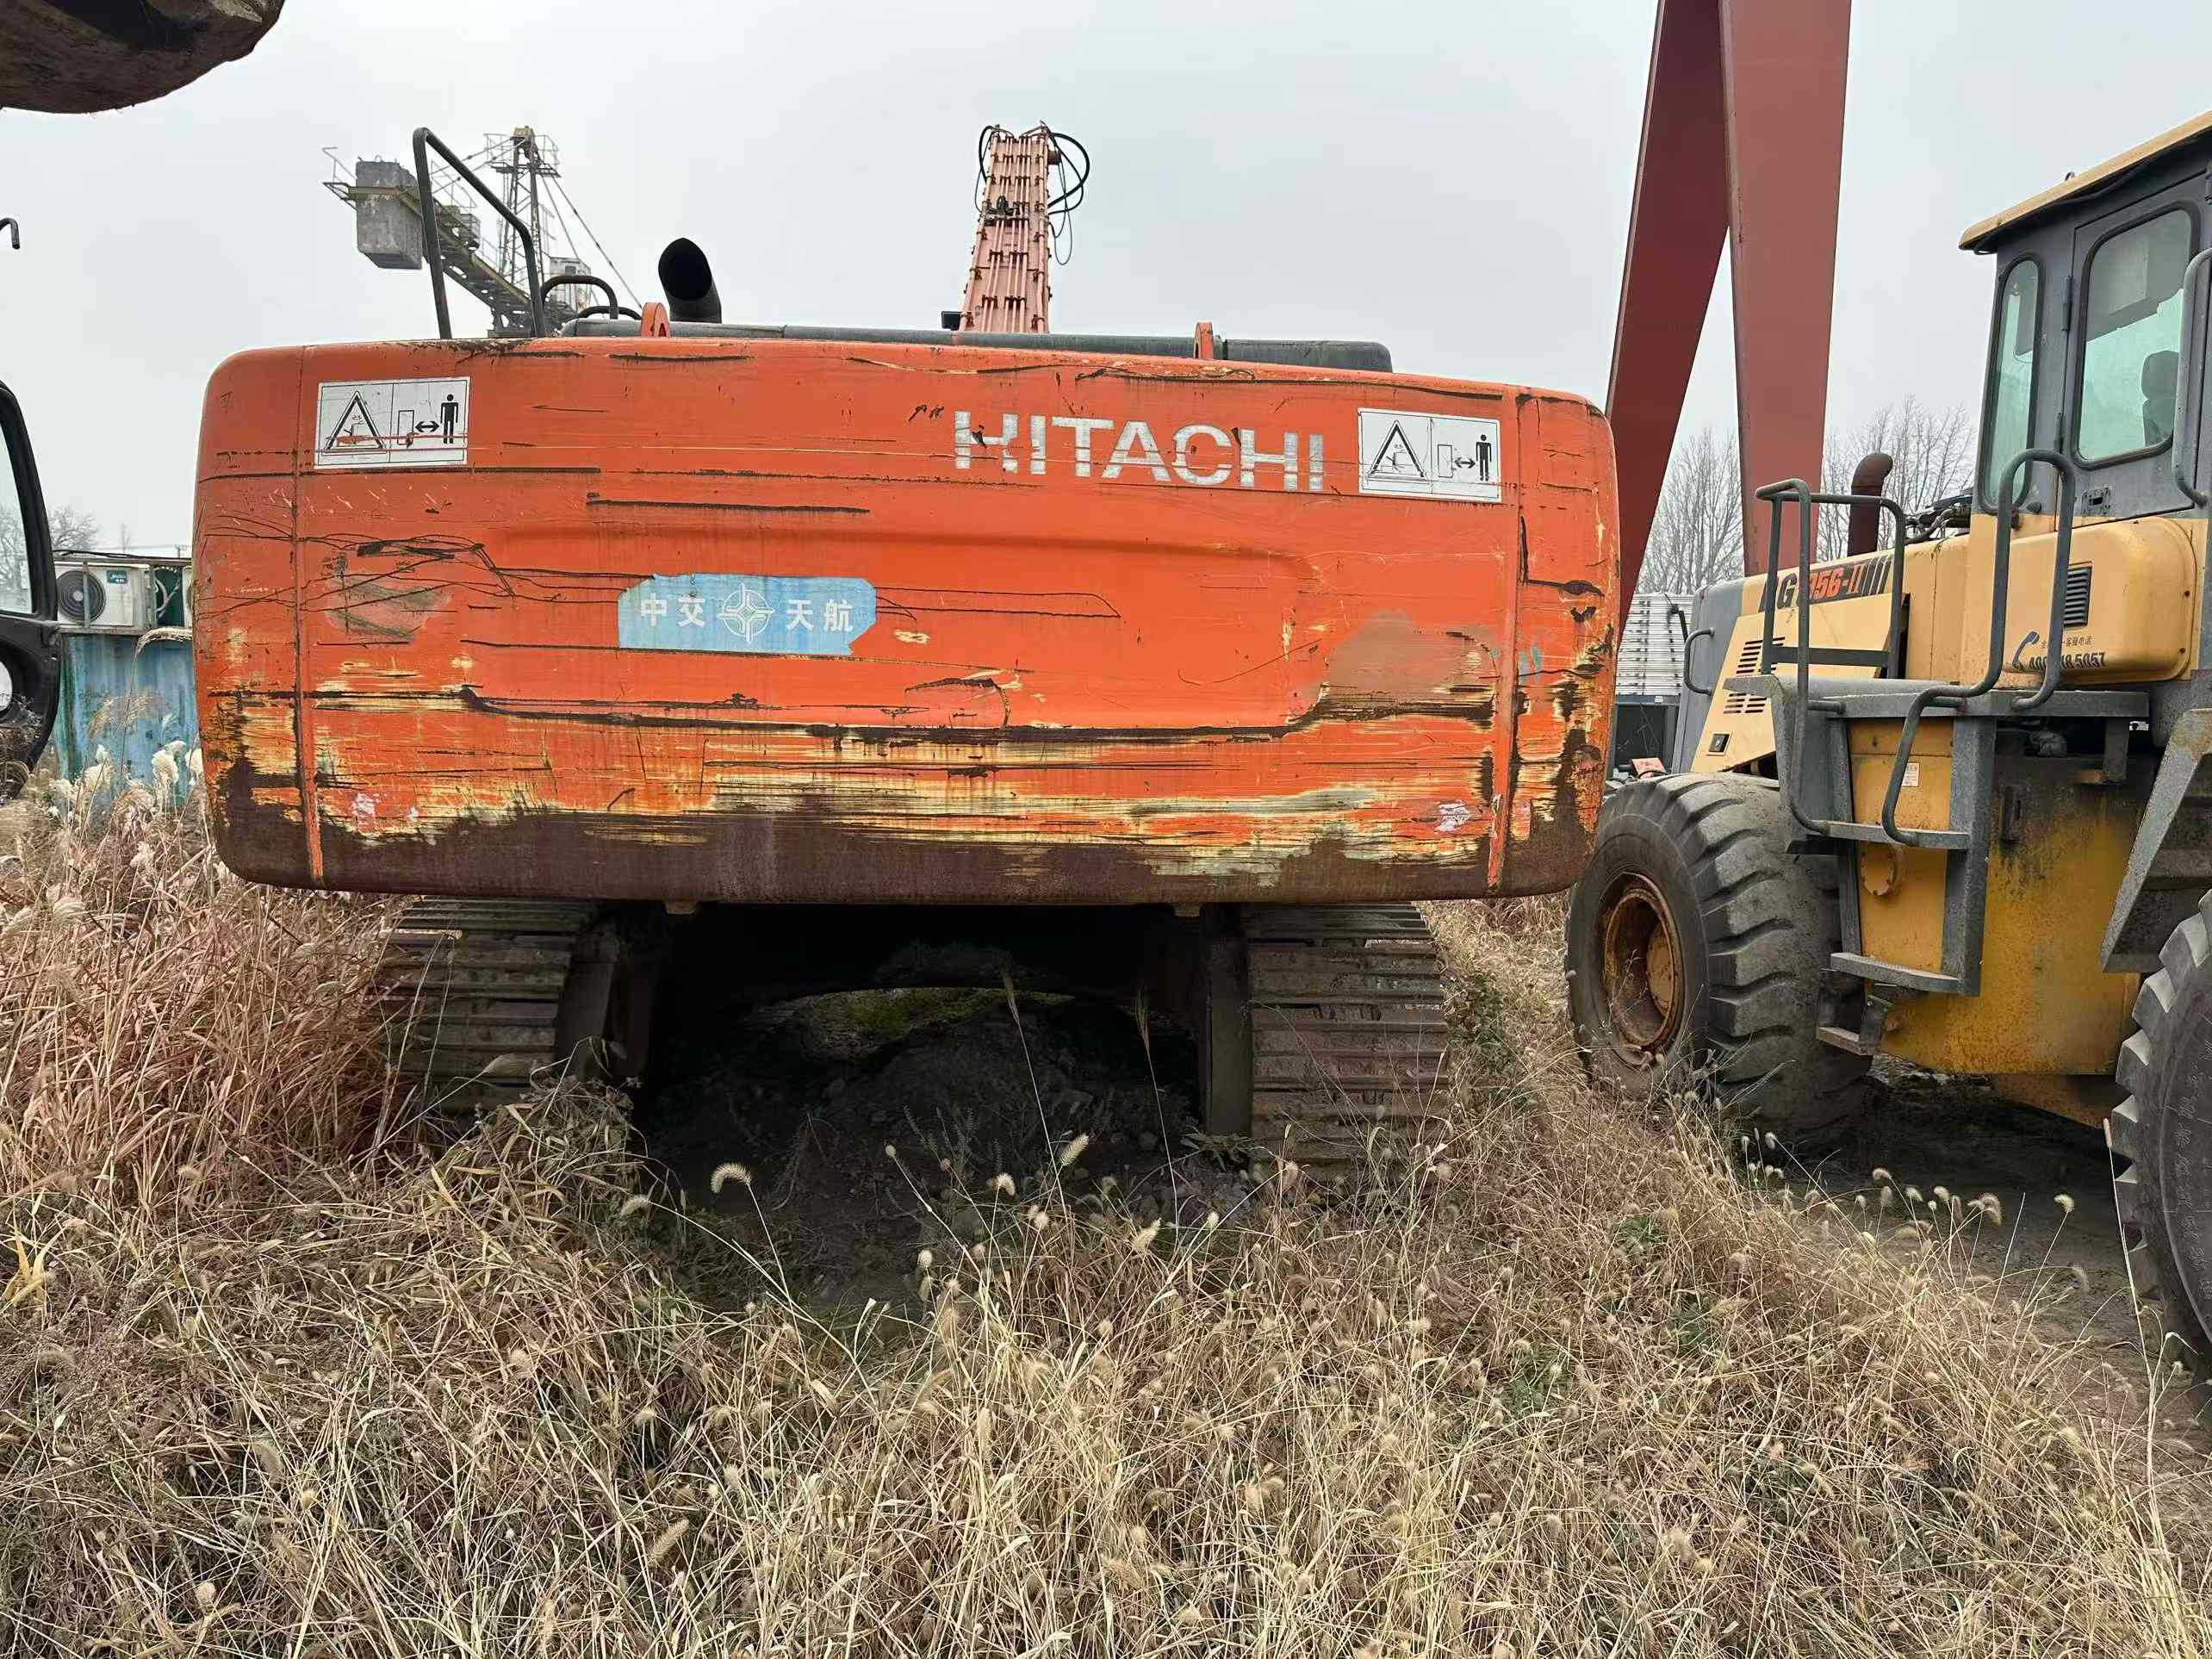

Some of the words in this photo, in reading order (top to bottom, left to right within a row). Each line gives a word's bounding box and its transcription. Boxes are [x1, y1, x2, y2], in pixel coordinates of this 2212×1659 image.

[954, 410, 1323, 491] HITACHI
[640, 593, 705, 627] 中交
[786, 598, 853, 632] 天航
